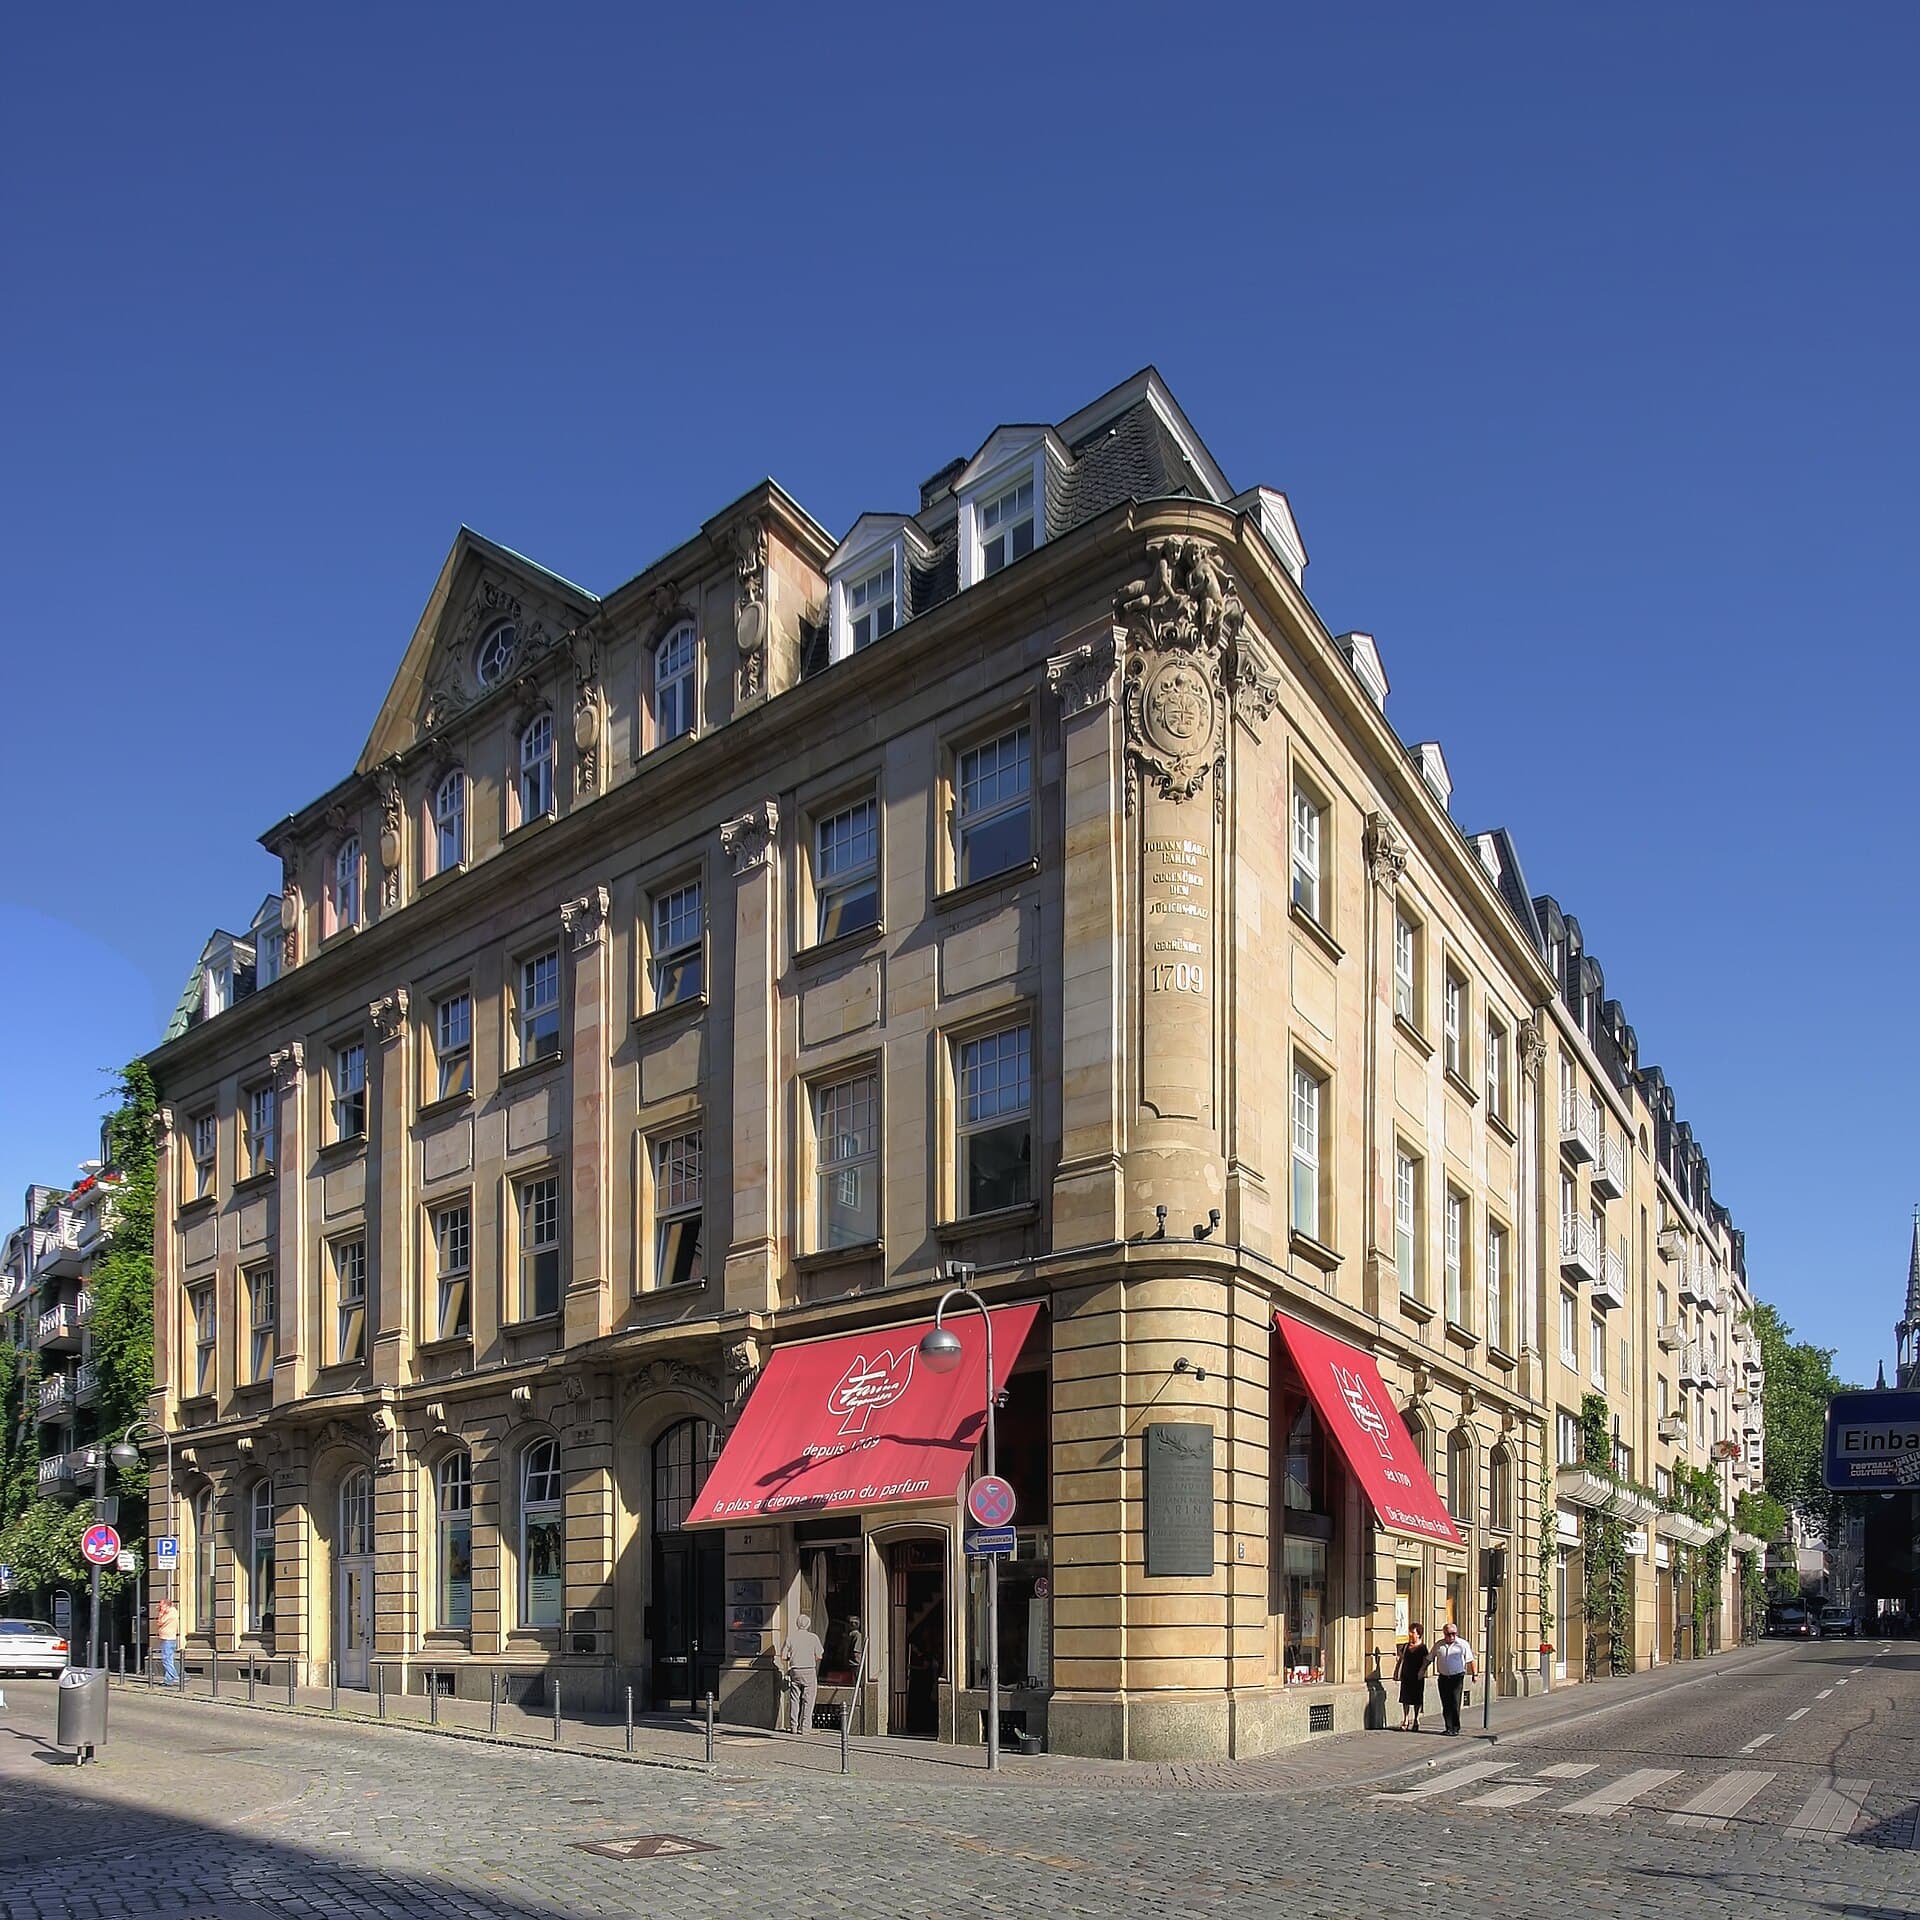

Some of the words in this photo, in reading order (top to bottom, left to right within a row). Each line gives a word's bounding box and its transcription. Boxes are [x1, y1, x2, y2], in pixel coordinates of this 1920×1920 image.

[1144, 841, 1182, 853] JOHANN
[1183, 840, 1210, 858] MARIA
[1162, 852, 1197, 866] FARINA
[1151, 962, 1204, 994] 1709
[1845, 1429, 1919, 1451] Einba
[802, 1442, 846, 1459] depuis
[713, 1500, 724, 1512] la
[725, 1497, 752, 1514] plus
[810, 1489, 856, 1504] maison
[859, 1484, 878, 1498] du
[879, 1478, 929, 1499] parfum
[743, 1535, 752, 1545] 21
